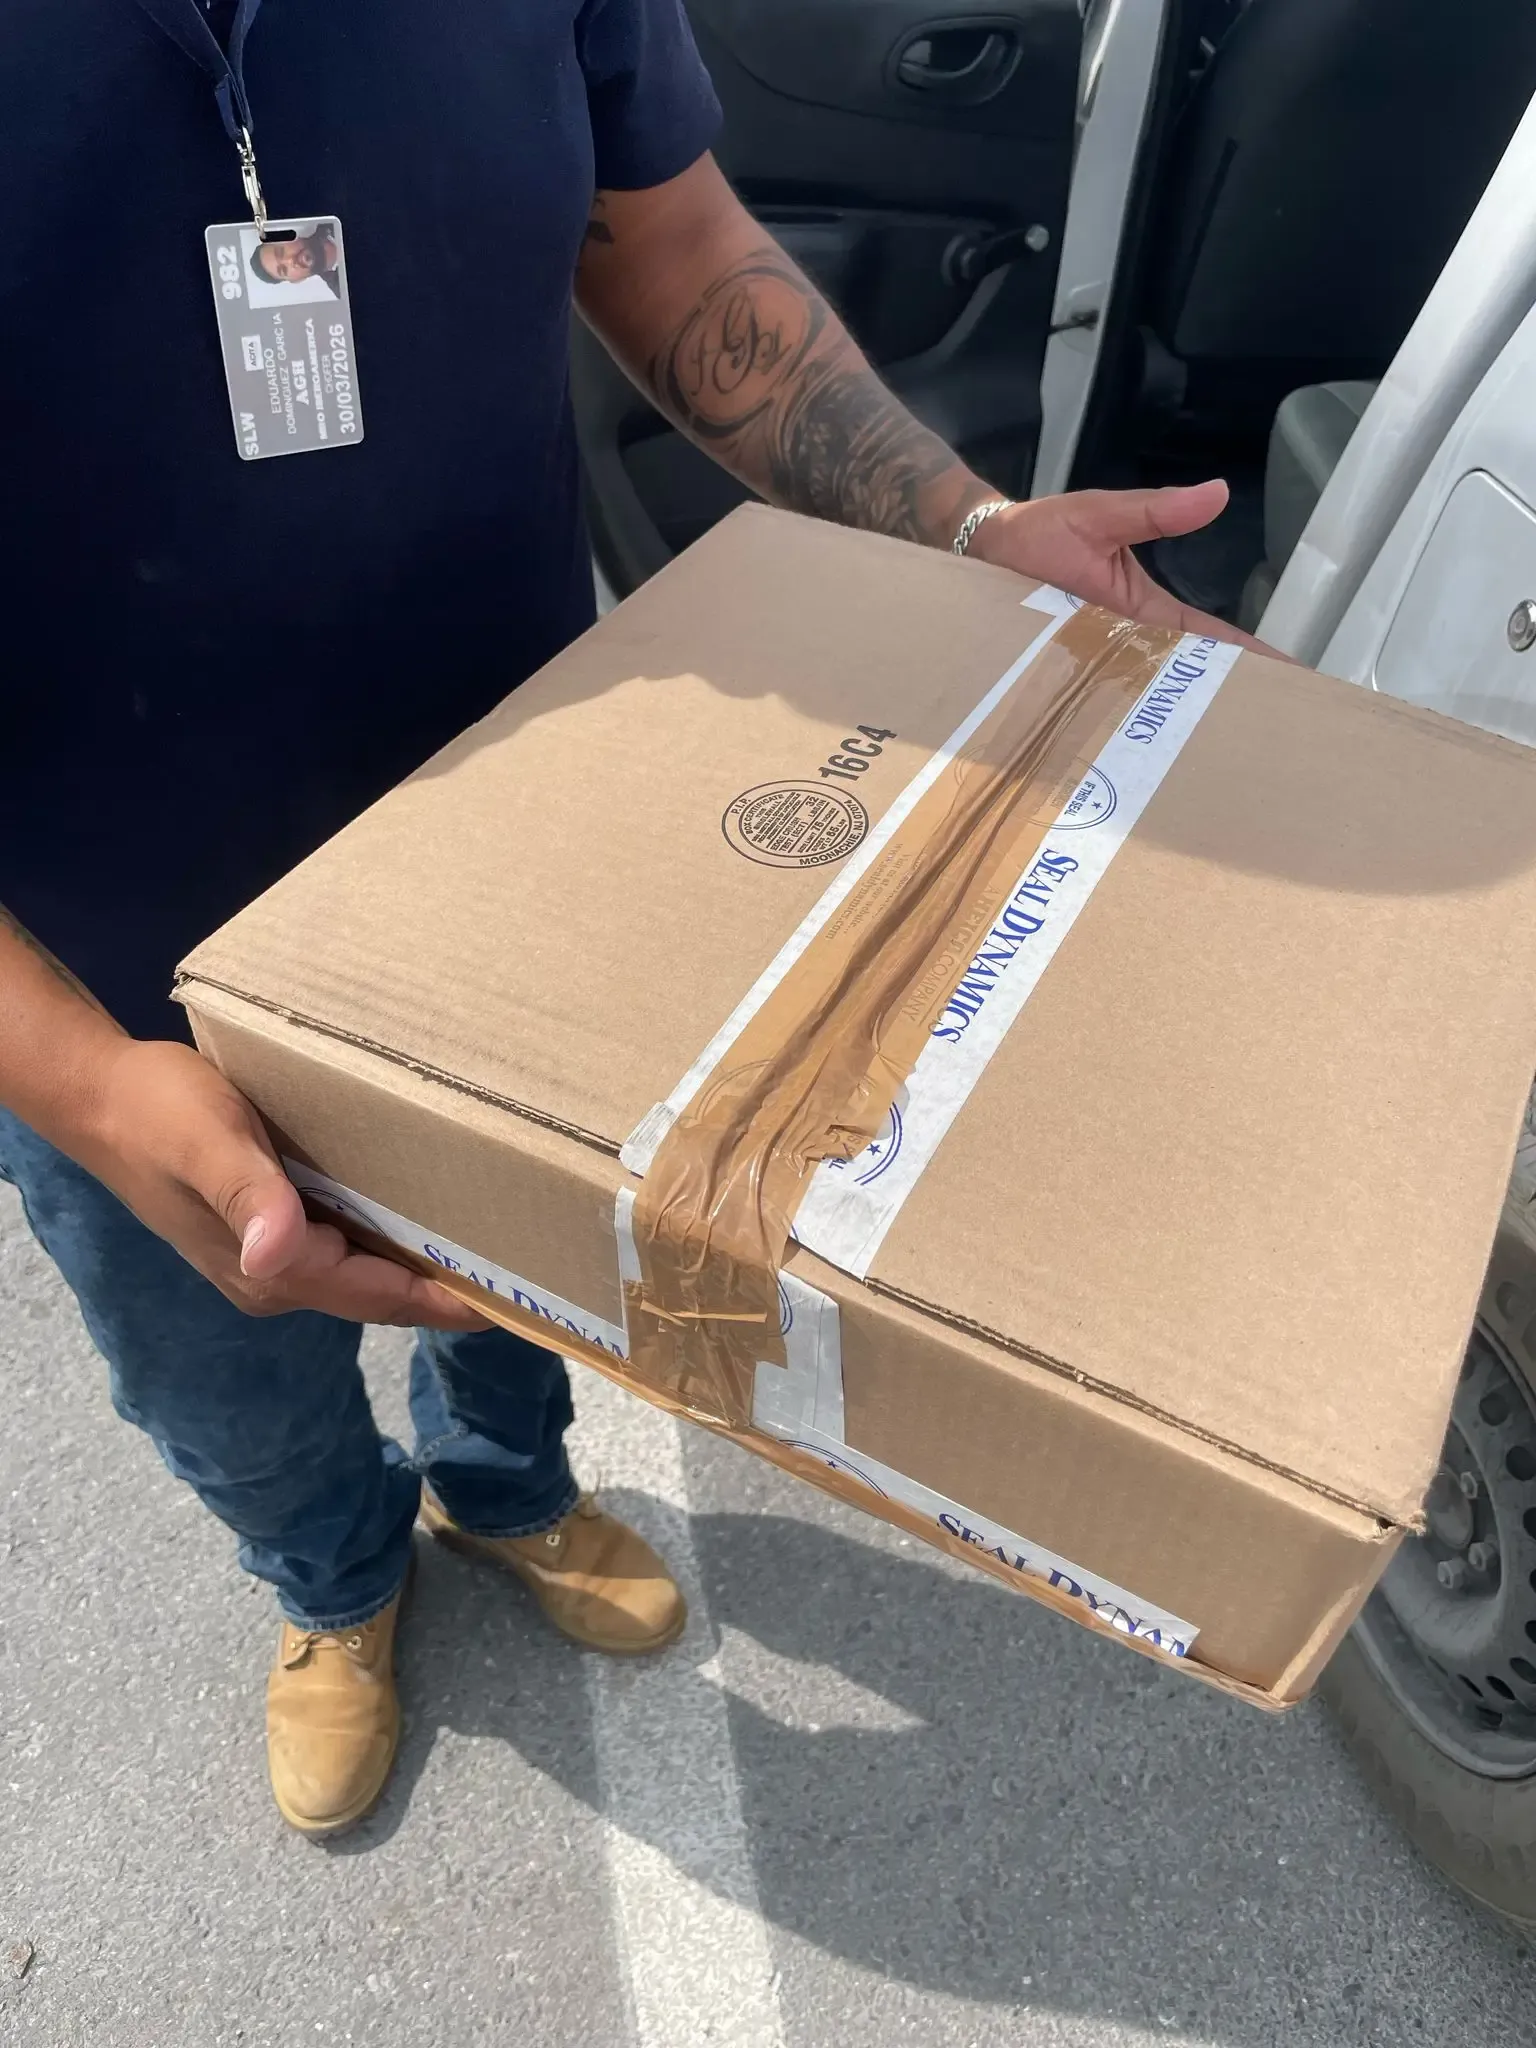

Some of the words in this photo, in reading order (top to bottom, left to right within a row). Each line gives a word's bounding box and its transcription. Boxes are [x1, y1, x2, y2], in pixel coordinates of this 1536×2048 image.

[217, 244, 242, 300] 982
[264, 348, 282, 414] EDUARDO
[280, 366, 297, 435] DOMINGUEZ
[329, 323, 356, 434] 30/03/2026
[240, 412, 259, 456] SLW
[1180, 638, 1218, 661] EAL
[1124, 659, 1206, 745] DYNAMICS
[818, 725, 897, 781] 16C4
[730, 798, 752, 815] P.I.P.
[744, 794, 785, 822] CERTIFICATE
[844, 799, 864, 820] 07074
[1064, 800, 1083, 816] SEAL
[1074, 788, 1093, 803] THIS
[770, 836, 786, 851] EDGE
[783, 817, 800, 835] CRUSH
[805, 796, 820, 807] 32
[779, 838, 793, 852] TEST
[791, 821, 808, 838] (ECT)
[853, 821, 864, 832] NJ
[799, 832, 861, 865] MOONACHIE,
[1014, 847, 1079, 907] SEAL
[900, 948, 956, 1023] COMPANY
[928, 904, 1046, 1045] DYNAMICS
